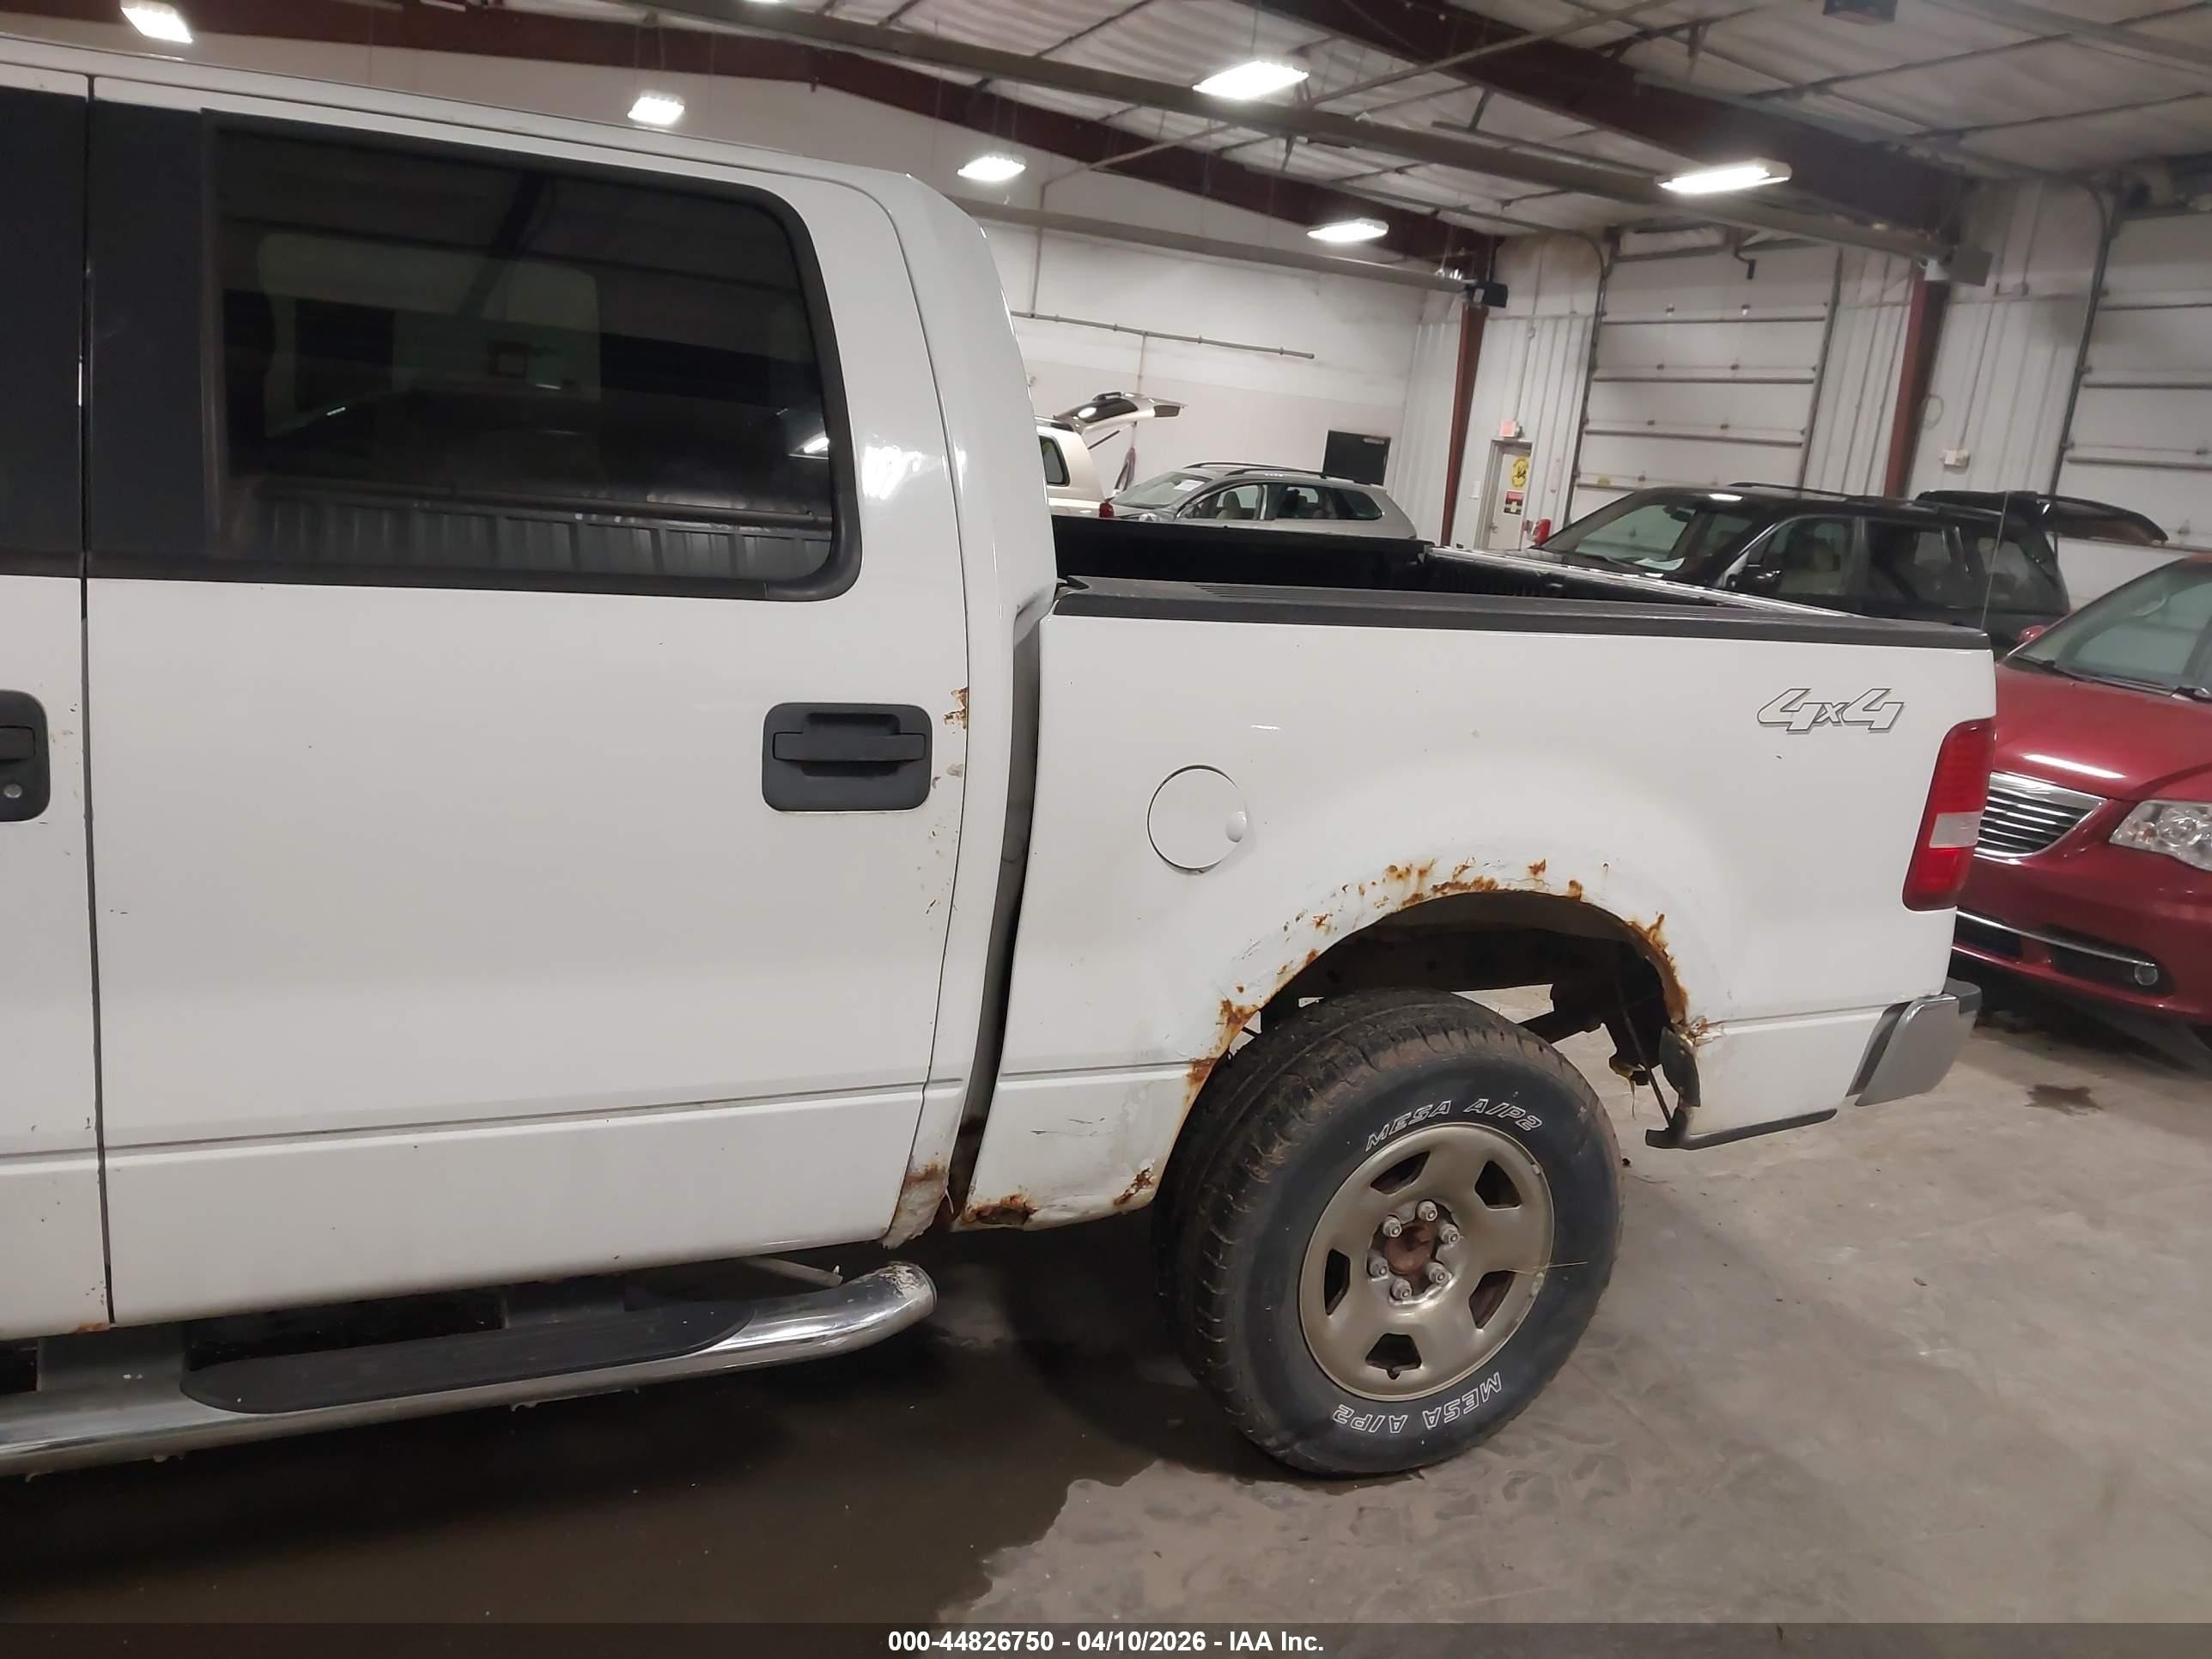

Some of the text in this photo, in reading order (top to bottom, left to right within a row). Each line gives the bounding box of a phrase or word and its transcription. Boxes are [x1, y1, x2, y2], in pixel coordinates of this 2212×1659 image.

[1757, 688, 1904, 732] 4x4
[1365, 1100, 1451, 1152] MESA
[1422, 1371, 1503, 1430] MESA
